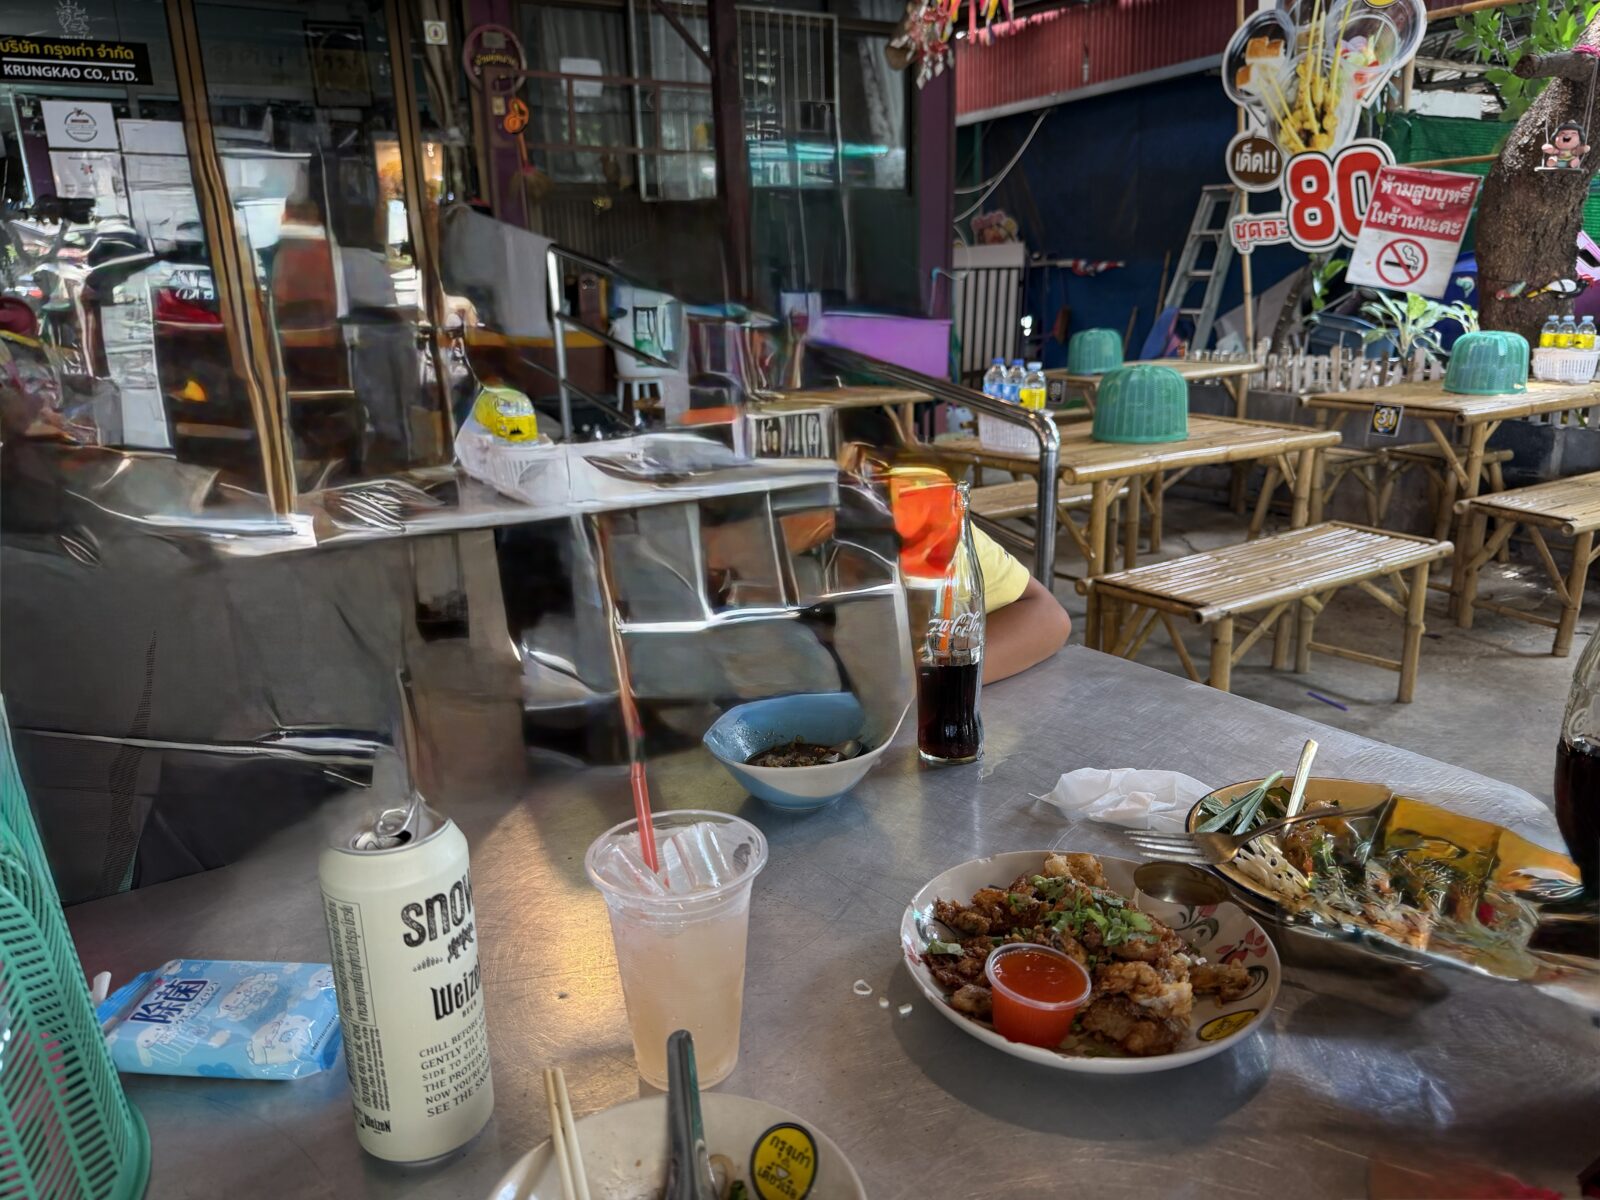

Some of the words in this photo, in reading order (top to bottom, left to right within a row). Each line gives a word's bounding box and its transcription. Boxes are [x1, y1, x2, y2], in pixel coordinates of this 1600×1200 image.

[0, 40, 40, 54] บริษัท
[43, 43, 94, 59] กรุงเก่า
[97, 44, 134, 60] จำกัด
[3, 64, 80, 79] KRUNGKAO
[83, 69, 110, 81] CO.,
[111, 70, 138, 82] LTD.
[1235, 143, 1278, 174] เด็ด!!
[1287, 149, 1386, 244] 80
[1380, 174, 1475, 210] ห้ามสูบบุหรี่
[1369, 201, 1462, 236] ในร้านนะคะ
[1234, 219, 1288, 250] ชุดละ
[1377, 407, 1396, 426] 31
[130, 977, 209, 1024] 除菌
[430, 957, 481, 1020] Weize
[419, 1041, 450, 1058] CHILL
[451, 1018, 478, 1045] BEFORE
[421, 1045, 462, 1071] GENTLY
[422, 1066, 447, 1081] SIDE
[449, 1059, 462, 1071] TO
[424, 1078, 447, 1093] THE
[425, 1089, 451, 1105] NOW
[427, 1101, 451, 1118] SEE
[452, 1086, 474, 1106] THE
